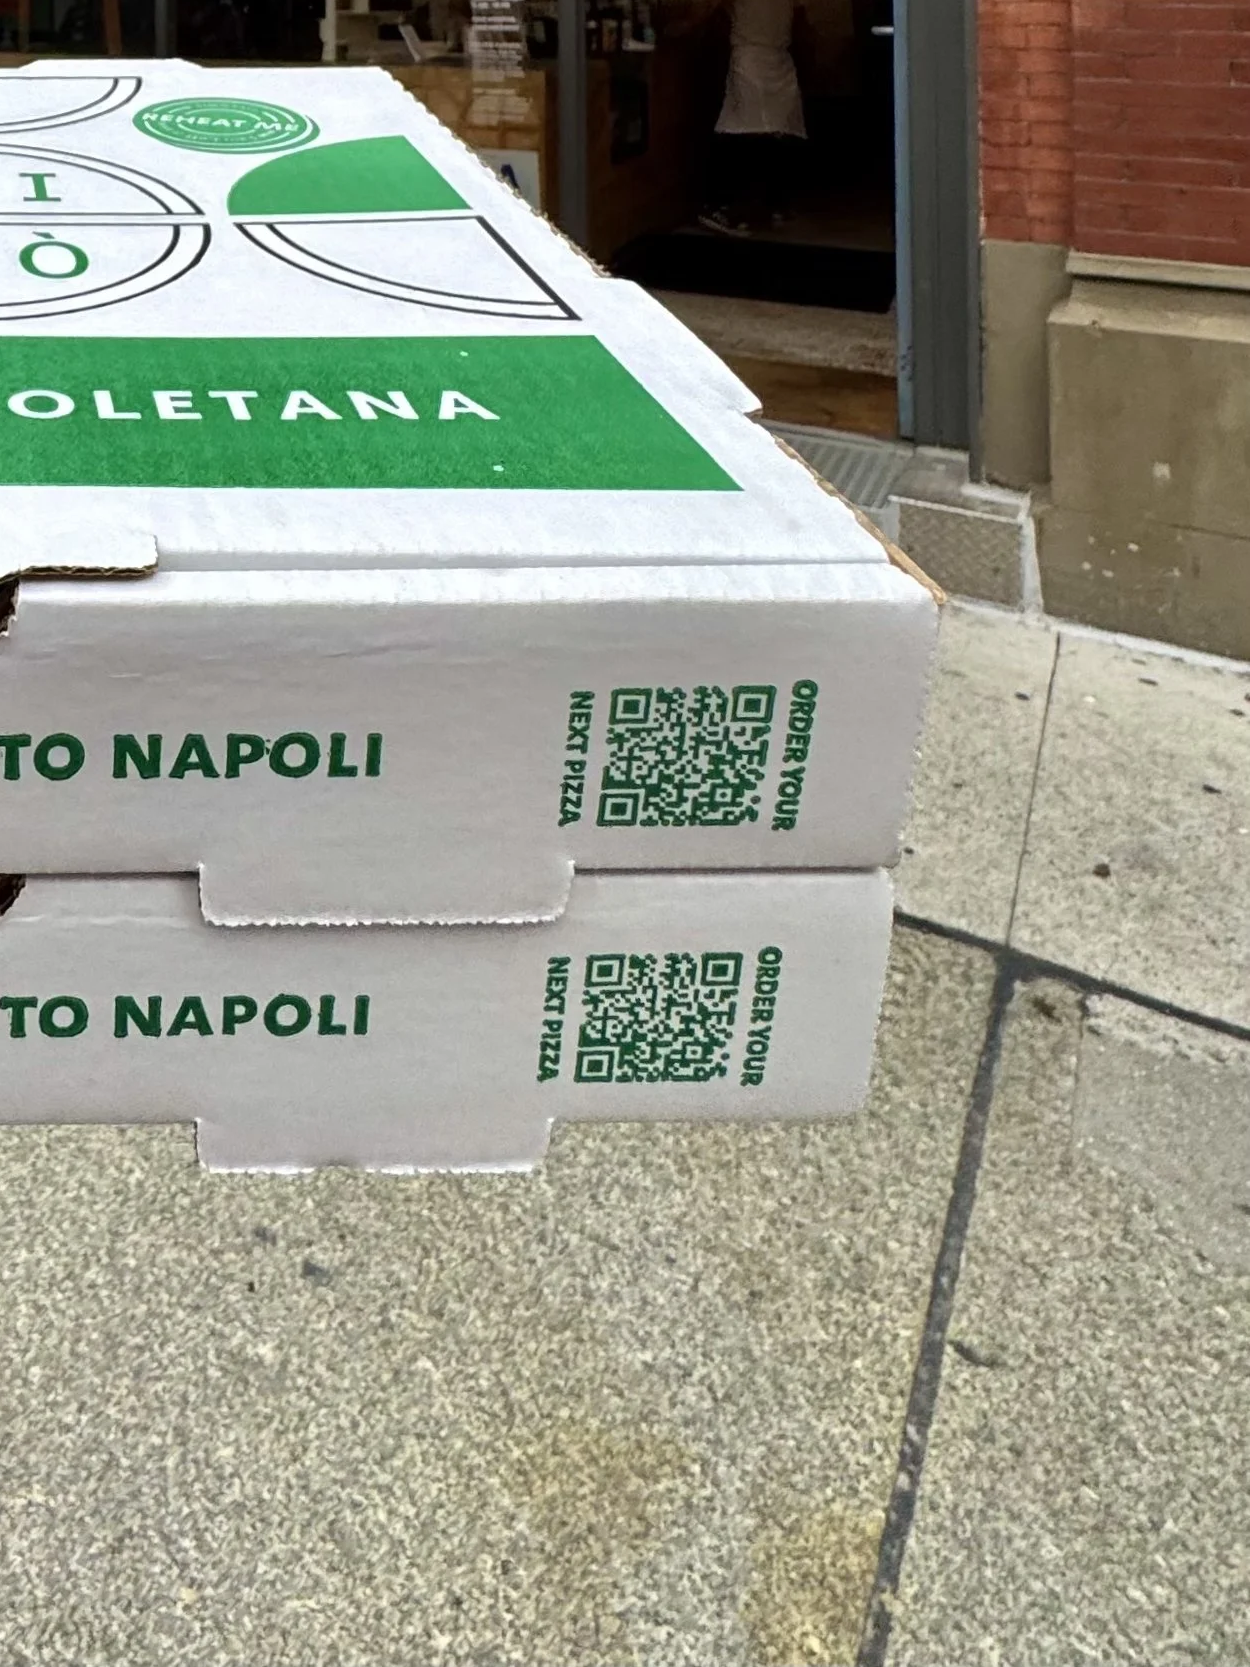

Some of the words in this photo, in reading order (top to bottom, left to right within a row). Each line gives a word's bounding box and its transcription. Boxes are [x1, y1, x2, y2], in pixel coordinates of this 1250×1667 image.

[142, 112, 247, 128] REHEAT
[254, 121, 299, 132] ME
[564, 690, 595, 755] NEXT
[782, 679, 819, 763] ORDER
[112, 730, 383, 780] NAPOLI
[557, 758, 588, 827] PIZZA
[771, 765, 806, 832] YOUR
[113, 992, 371, 1039] NAPOLI
[543, 956, 572, 1015] NEXT
[750, 946, 783, 1024] ORDER
[536, 1019, 564, 1084] PIZZA
[739, 1025, 772, 1086] YOUR
